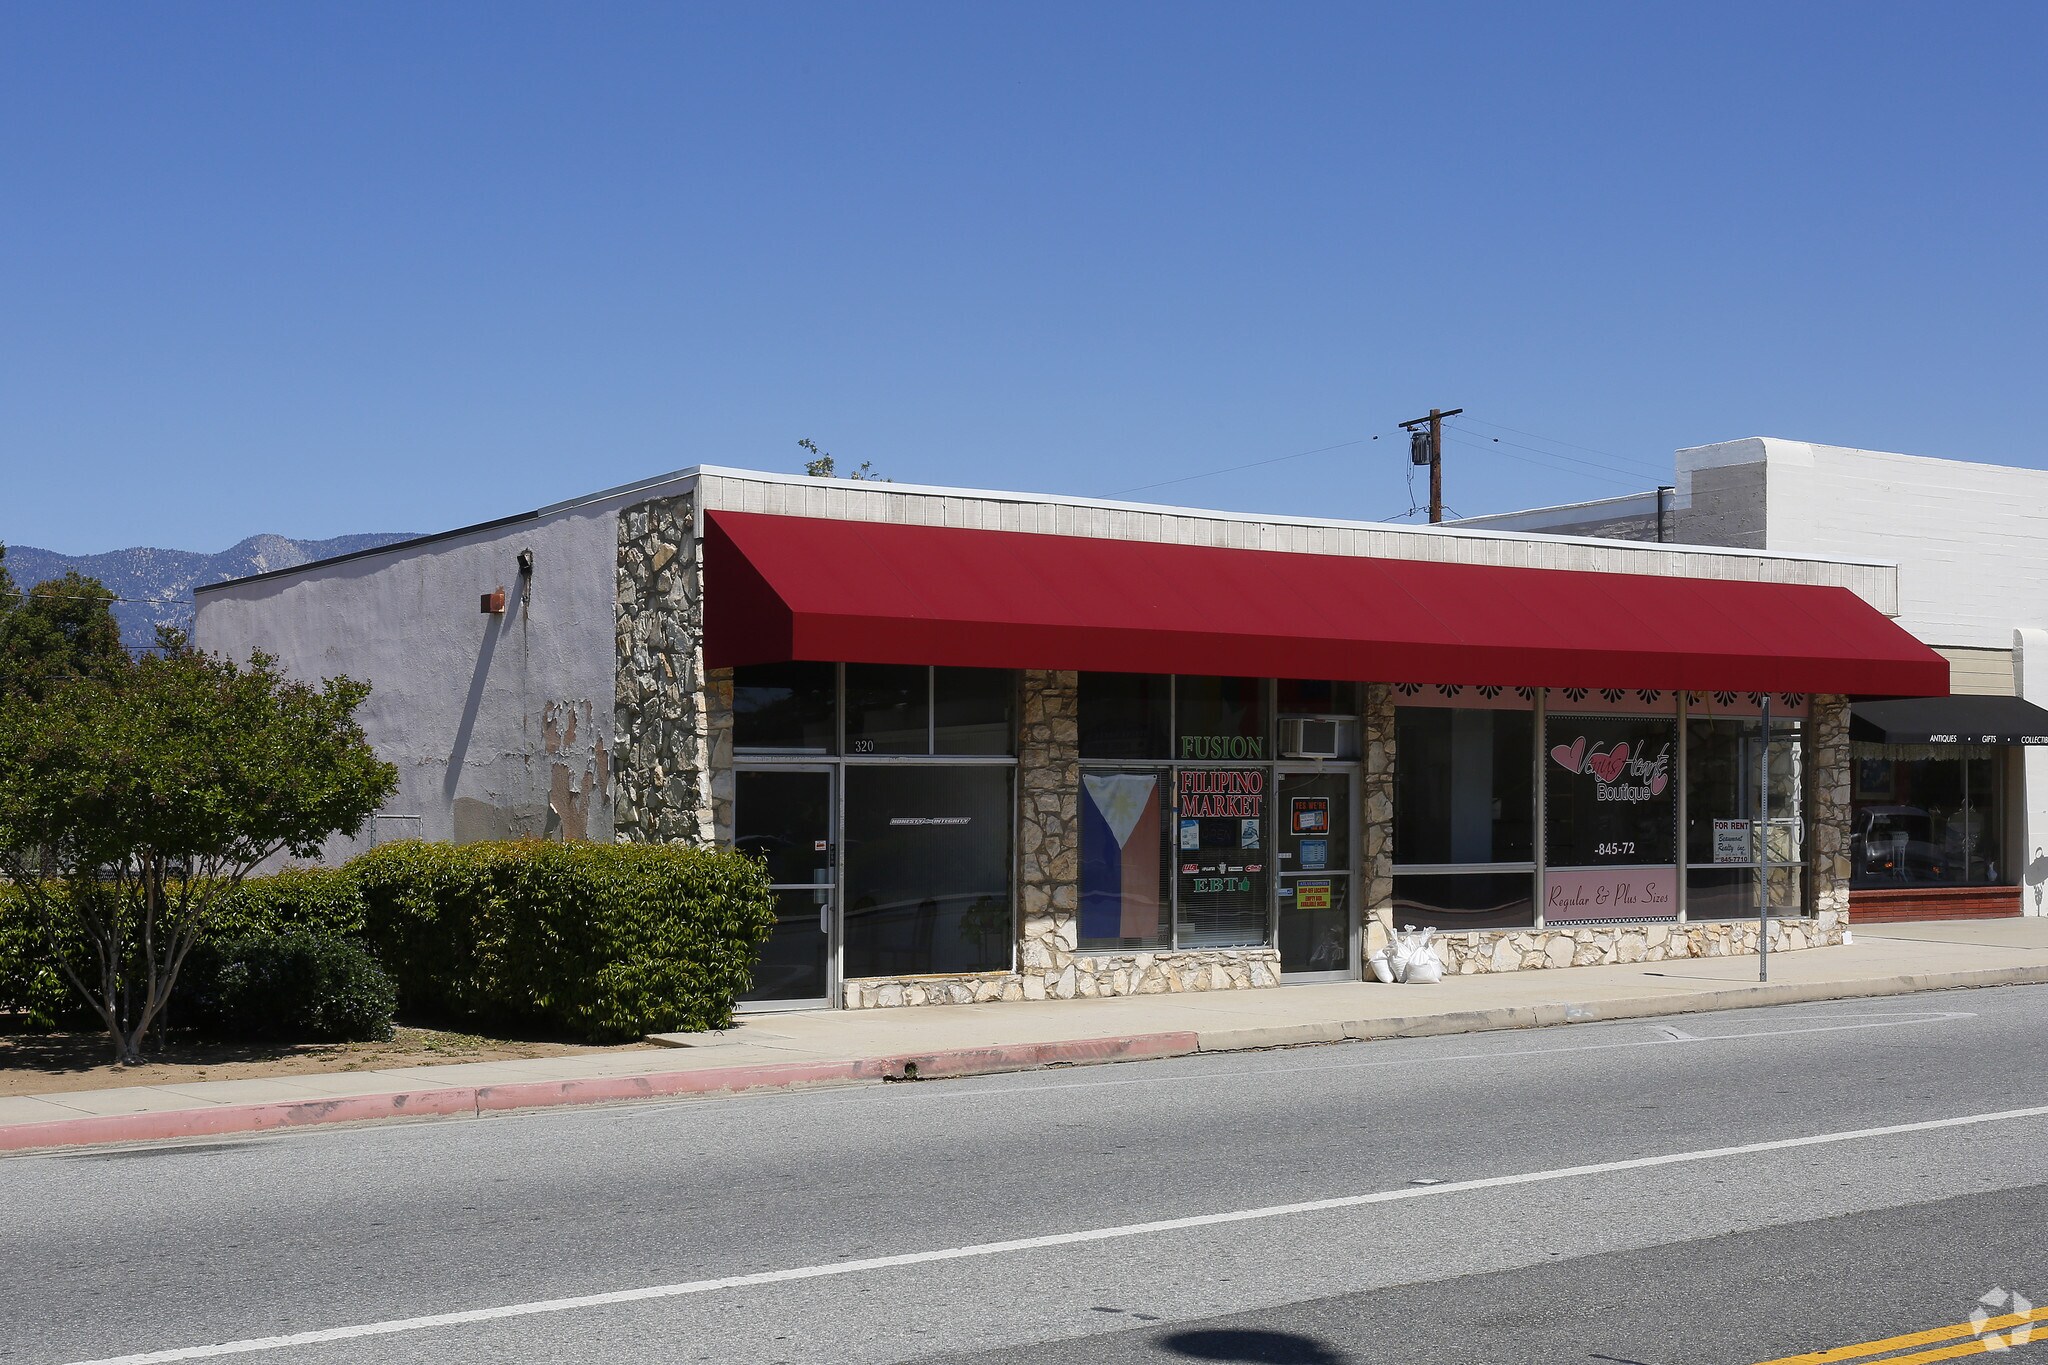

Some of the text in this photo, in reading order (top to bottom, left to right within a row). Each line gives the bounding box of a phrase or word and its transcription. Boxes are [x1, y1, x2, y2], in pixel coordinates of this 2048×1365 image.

[855, 740, 874, 752] 320
[1929, 734, 1958, 743] ANTIQUES
[1981, 735, 1997, 743] GIFTS
[1181, 735, 1264, 759] FUSION
[1181, 771, 1263, 794] FILIPINO
[1596, 782, 1651, 804] Boutique
[1181, 795, 1262, 817] MARKET
[1295, 801, 1326, 810] YES WE'RE
[1714, 821, 1749, 830] FOR RENT
[1594, 842, 1635, 855] -845-72
[1193, 877, 1239, 893] EBT
[1548, 882, 1669, 912] Regular & Plus Sizes
